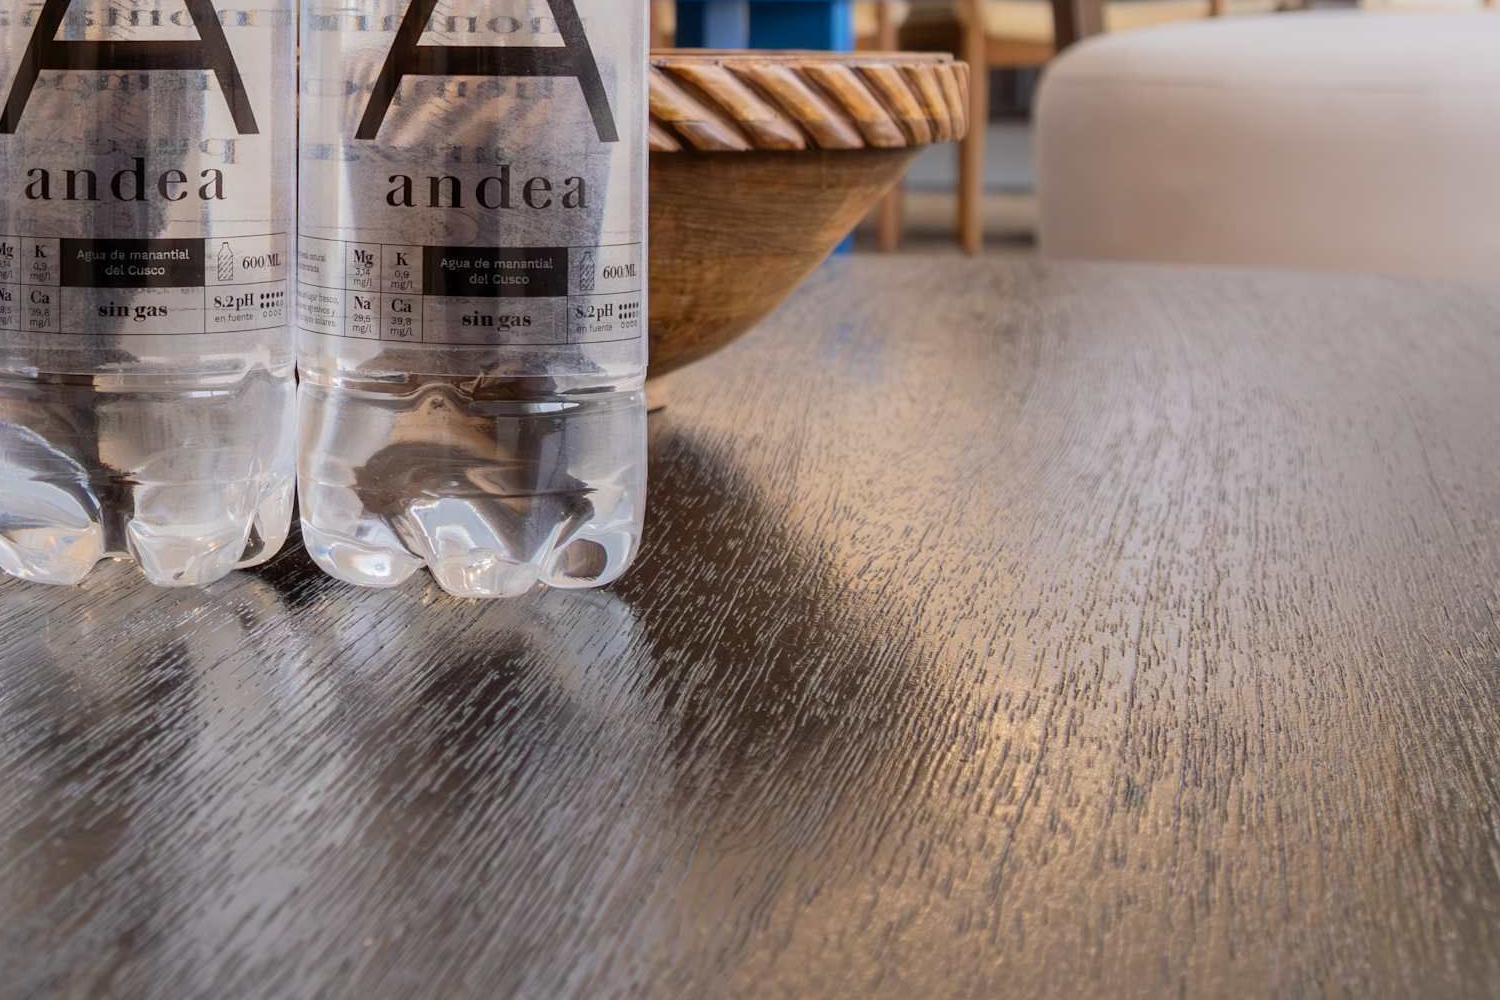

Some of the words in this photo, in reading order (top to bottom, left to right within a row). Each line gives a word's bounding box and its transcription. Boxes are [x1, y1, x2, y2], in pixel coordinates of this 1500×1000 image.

[24, 157, 227, 201] andea
[386, 164, 588, 209] andea
[34, 244, 46, 258] K
[76, 250, 106, 262] Agua
[110, 250, 125, 260] de
[130, 249, 190, 260] manantial
[354, 249, 374, 268] Mg
[396, 252, 408, 266] K
[440, 258, 470, 270] Agua
[474, 258, 490, 268] de
[494, 258, 553, 269] manantial
[105, 265, 124, 276] del
[128, 265, 165, 276] Cusco
[353, 278, 372, 288] mg/l
[390, 280, 413, 290] mg/l
[469, 273, 488, 284] del
[492, 274, 530, 284] Cusco
[30, 290, 49, 304] Ca
[354, 296, 371, 310] Na
[98, 302, 134, 317] sin
[133, 304, 168, 322] gas
[391, 299, 412, 313] Ca
[215, 314, 226, 323] en
[228, 312, 254, 322] fuente
[462, 311, 493, 327] sin
[497, 312, 532, 331] gas
[352, 325, 372, 334] mg/l
[390, 327, 413, 337] mg/l
[576, 324, 587, 333] en
[589, 323, 613, 332] fuente
